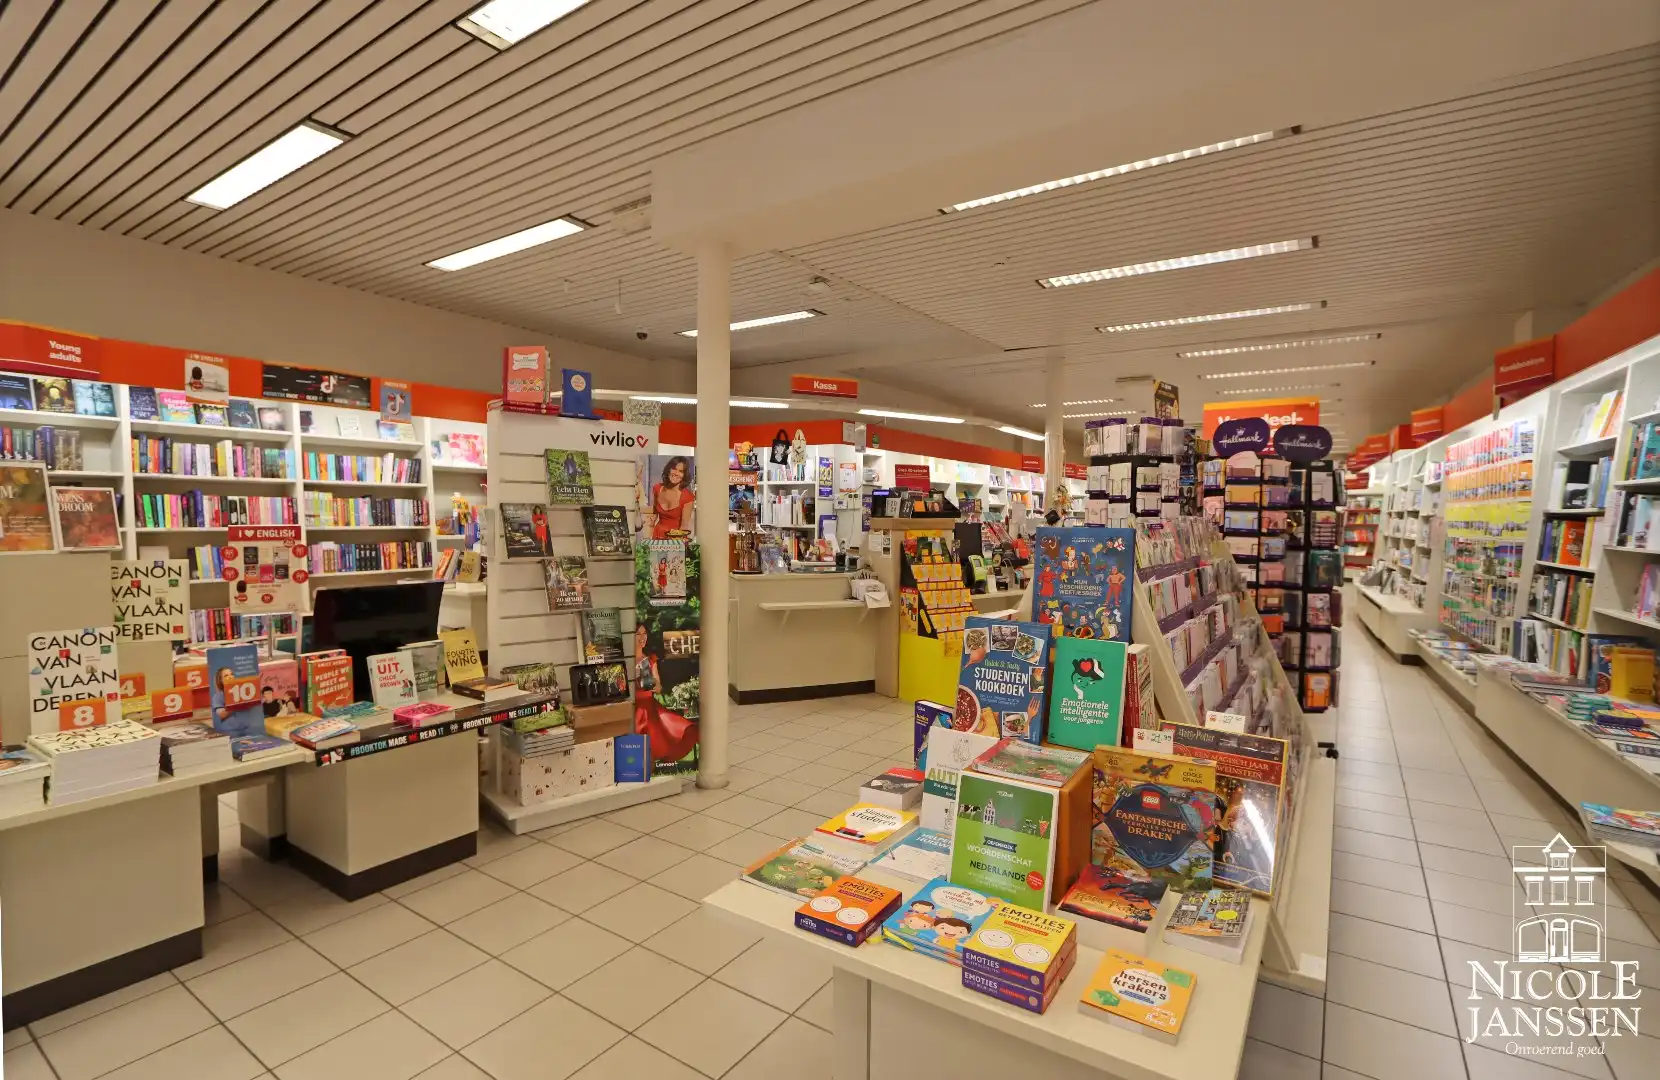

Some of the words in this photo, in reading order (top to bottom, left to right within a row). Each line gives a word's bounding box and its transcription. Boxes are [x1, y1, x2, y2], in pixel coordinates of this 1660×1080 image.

[49, 340, 81, 354] Young
[49, 352, 82, 362] adults
[813, 381, 838, 390] Kassa
[590, 431, 635, 448] vivlio
[1219, 432, 1264, 449] Hallmark
[1279, 440, 1326, 451] Hallmark
[256, 529, 296, 538] ENGLISH
[111, 585, 151, 598] VAN
[117, 603, 184, 617] VLAAN
[113, 622, 170, 637] DEREN
[31, 631, 115, 651] CANON
[446, 648, 475, 658] FOURTH
[448, 655, 478, 667] WING
[36, 654, 82, 670] VAN
[377, 662, 404, 675] UIT,
[44, 669, 117, 689] VLAAN
[187, 671, 202, 687] 5
[315, 670, 339, 682] PEOPLE
[974, 666, 1029, 685] STUDENTEN
[120, 680, 136, 697] 4
[229, 682, 256, 702] 10
[317, 682, 349, 697] VACATION
[975, 679, 1025, 697] KOOKBOEK
[163, 694, 183, 712] 9
[1061, 698, 1109, 710] Emotionele
[73, 706, 95, 726] 8
[463, 716, 493, 731] #BOOKTOK
[517, 706, 532, 716] READ
[531, 705, 538, 713] IT
[1060, 707, 1109, 719] intelligentie
[1076, 717, 1104, 725] jongeren
[350, 741, 387, 757] #BOOKTOK
[387, 735, 408, 748] MADE
[419, 730, 438, 741] READ
[438, 727, 445, 737] IT
[1210, 754, 1248, 767] MAGISCH
[1249, 761, 1269, 771] JAAR
[1215, 765, 1263, 779] WEINSTEIN
[1143, 796, 1160, 804] LEGO
[851, 812, 897, 826] studeren
[1115, 809, 1187, 831] FANTASTISCHE
[1127, 826, 1173, 841] DRAKEN
[966, 843, 1033, 867] WOORDENSCHAT
[969, 860, 1026, 882] NEDERLANDS
[842, 881, 886, 898] EMOTIES
[1000, 906, 1067, 931] EMOTIES
[965, 953, 1000, 970] EMOTIES
[964, 971, 998, 990] EMOTIES
[1112, 976, 1167, 1001] krakers
[1119, 970, 1167, 992] hersen
